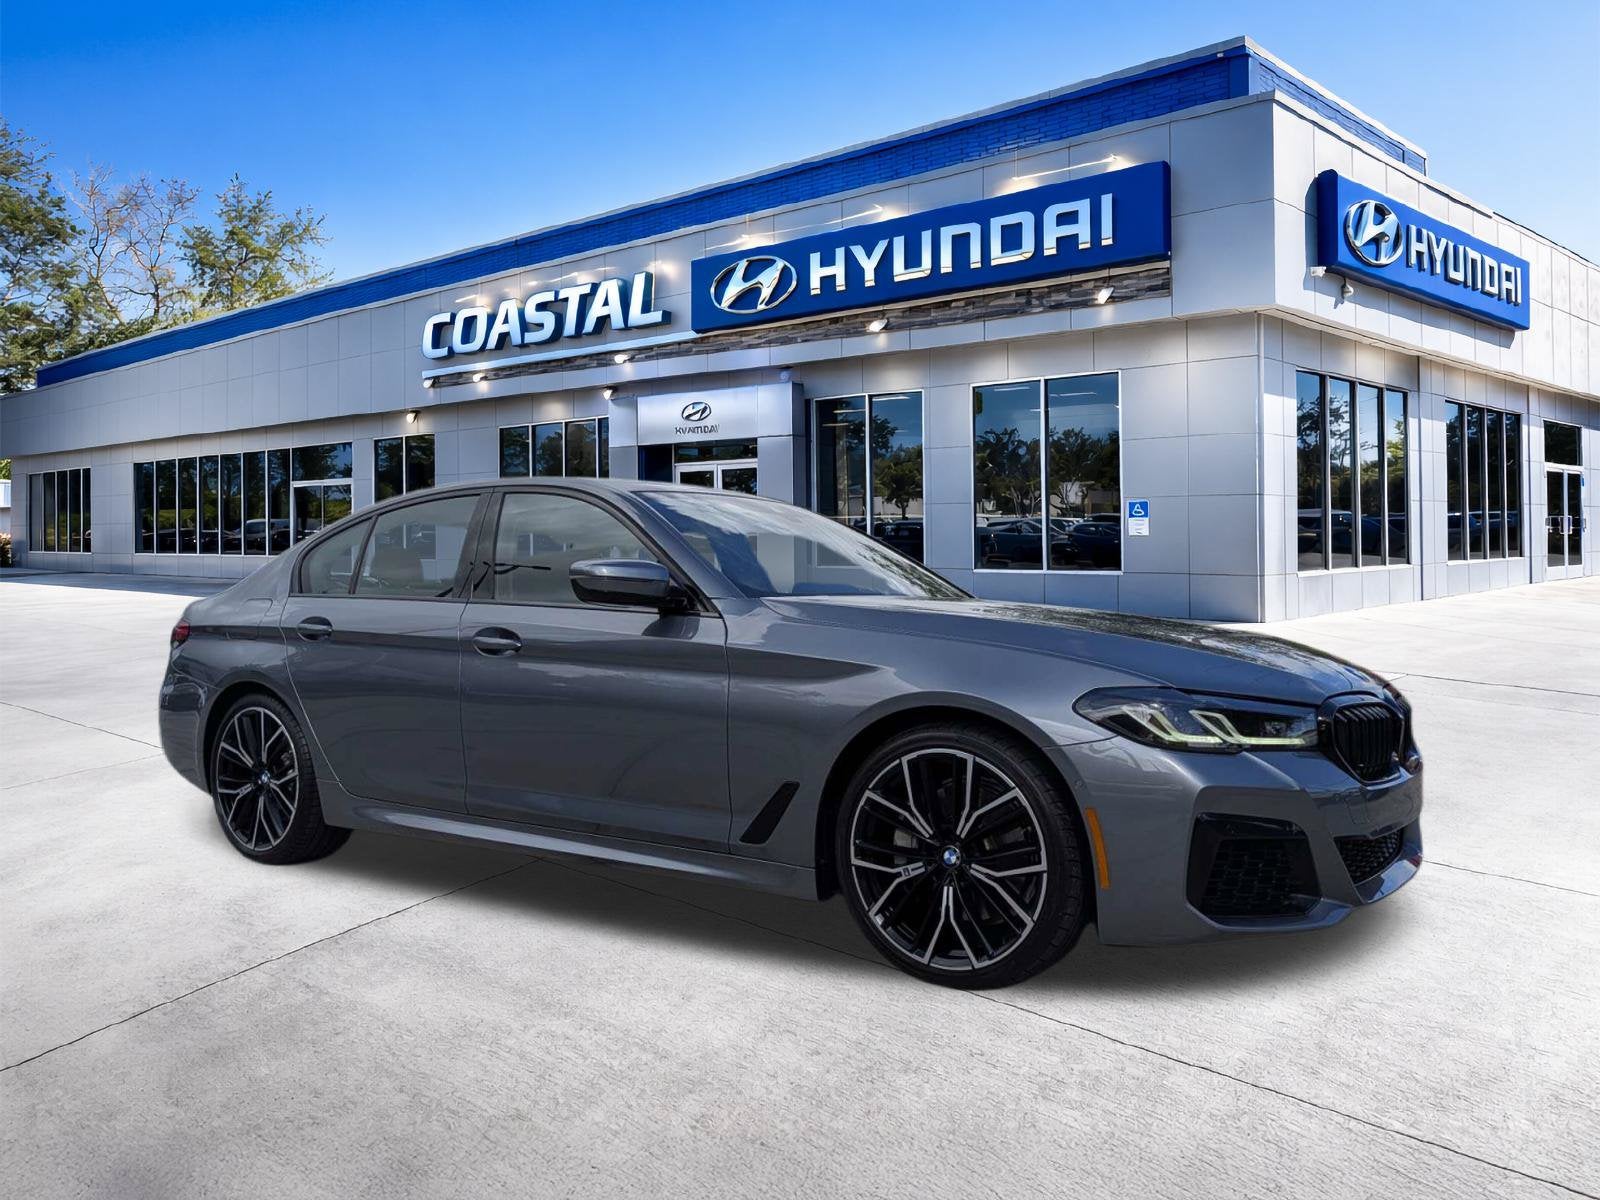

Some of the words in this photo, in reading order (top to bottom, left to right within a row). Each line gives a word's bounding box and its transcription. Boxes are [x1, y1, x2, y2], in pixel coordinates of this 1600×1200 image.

[809, 193, 1113, 295] HYUNDAI
[1407, 224, 1522, 306] HYUNDAI
[422, 271, 670, 359] COASTAL
